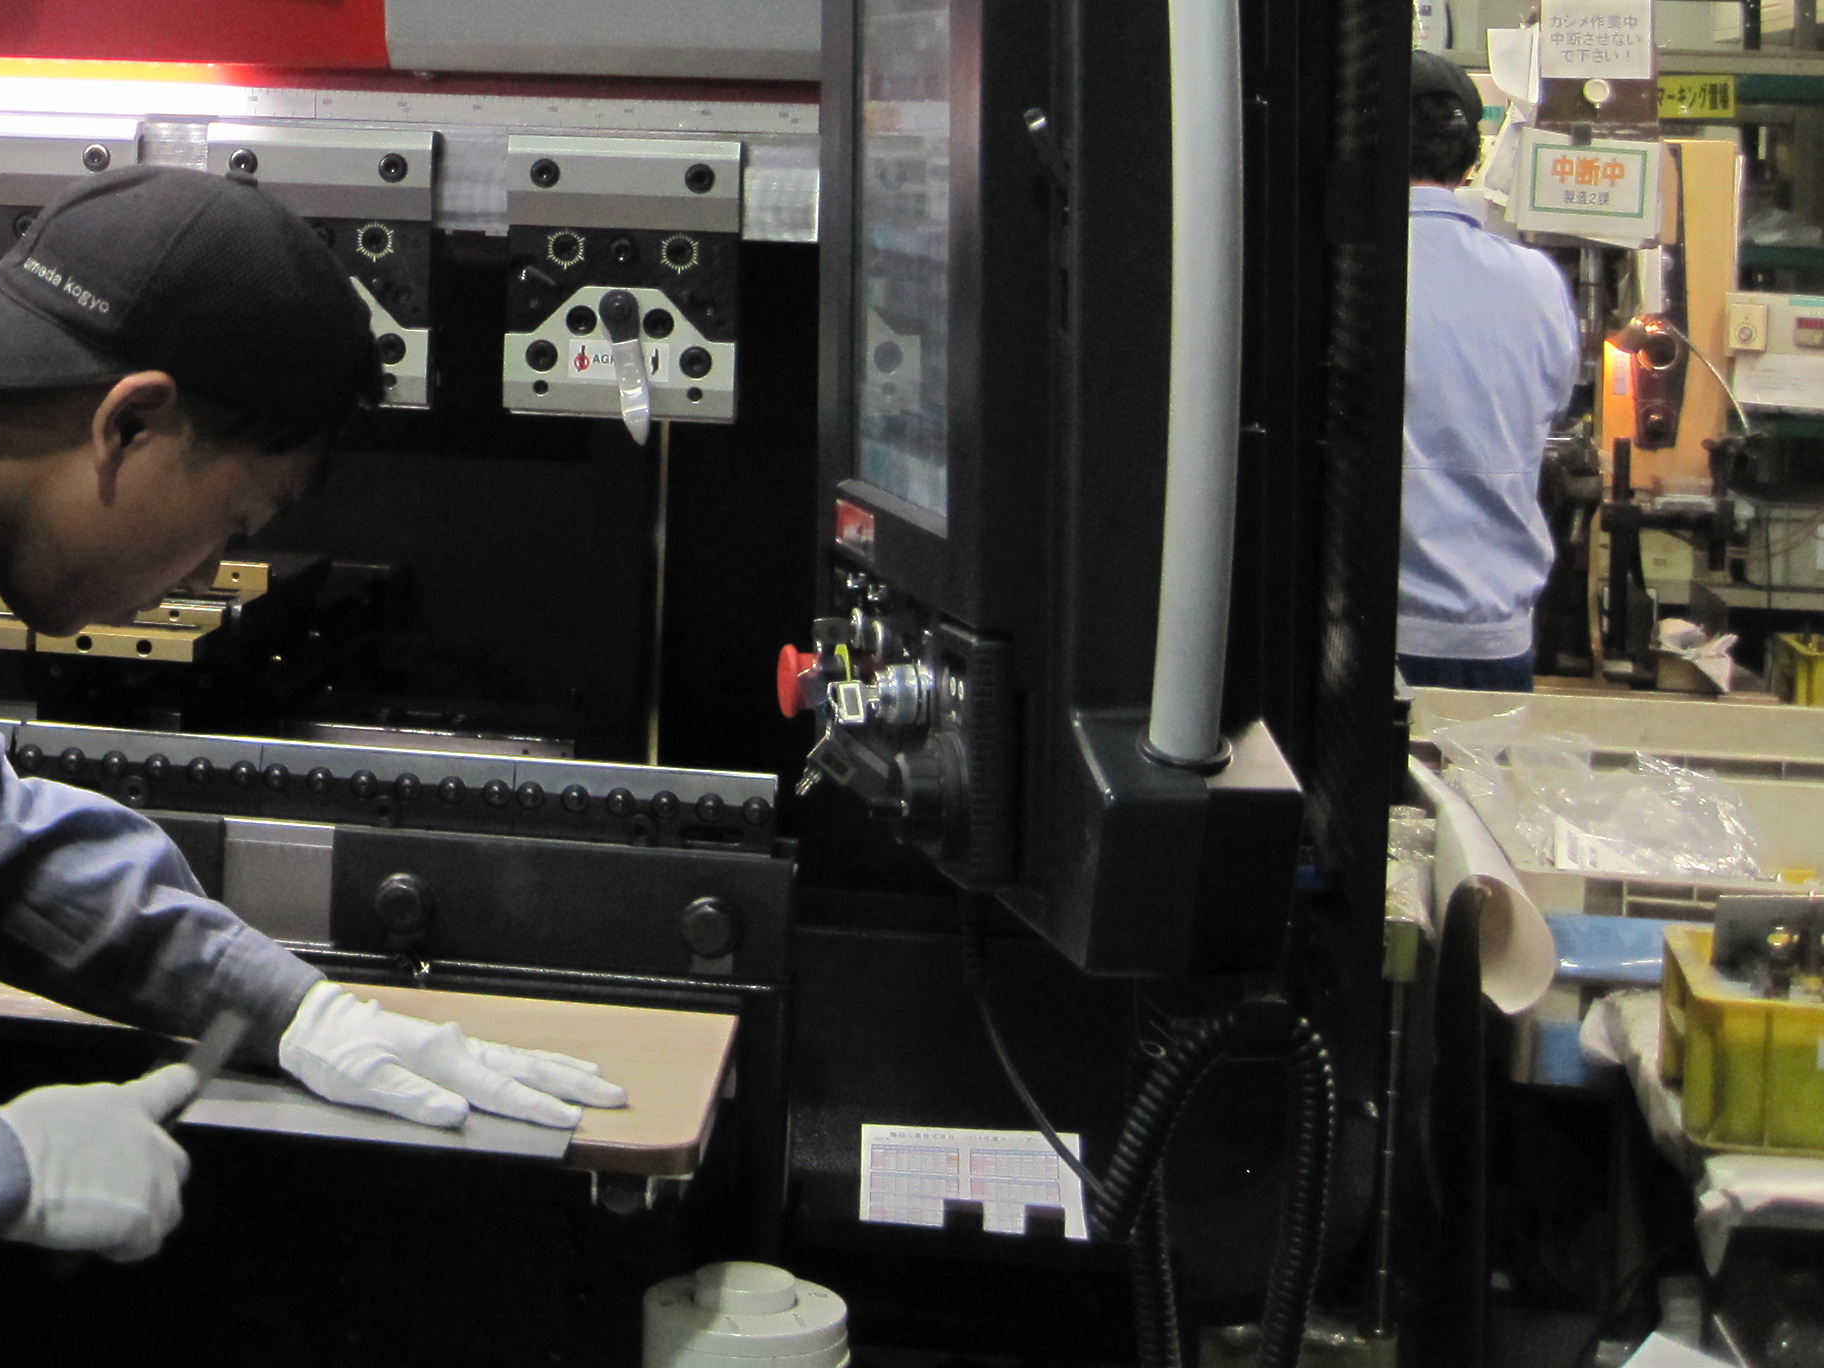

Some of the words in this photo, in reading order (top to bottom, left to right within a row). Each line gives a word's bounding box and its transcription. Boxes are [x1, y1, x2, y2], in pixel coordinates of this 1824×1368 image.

[1550, 15, 1638, 30] カシメ作業中
[1550, 32, 1641, 47] 中断させない
[1551, 154, 1625, 188] 中断中
[63, 276, 110, 313] kogyo
